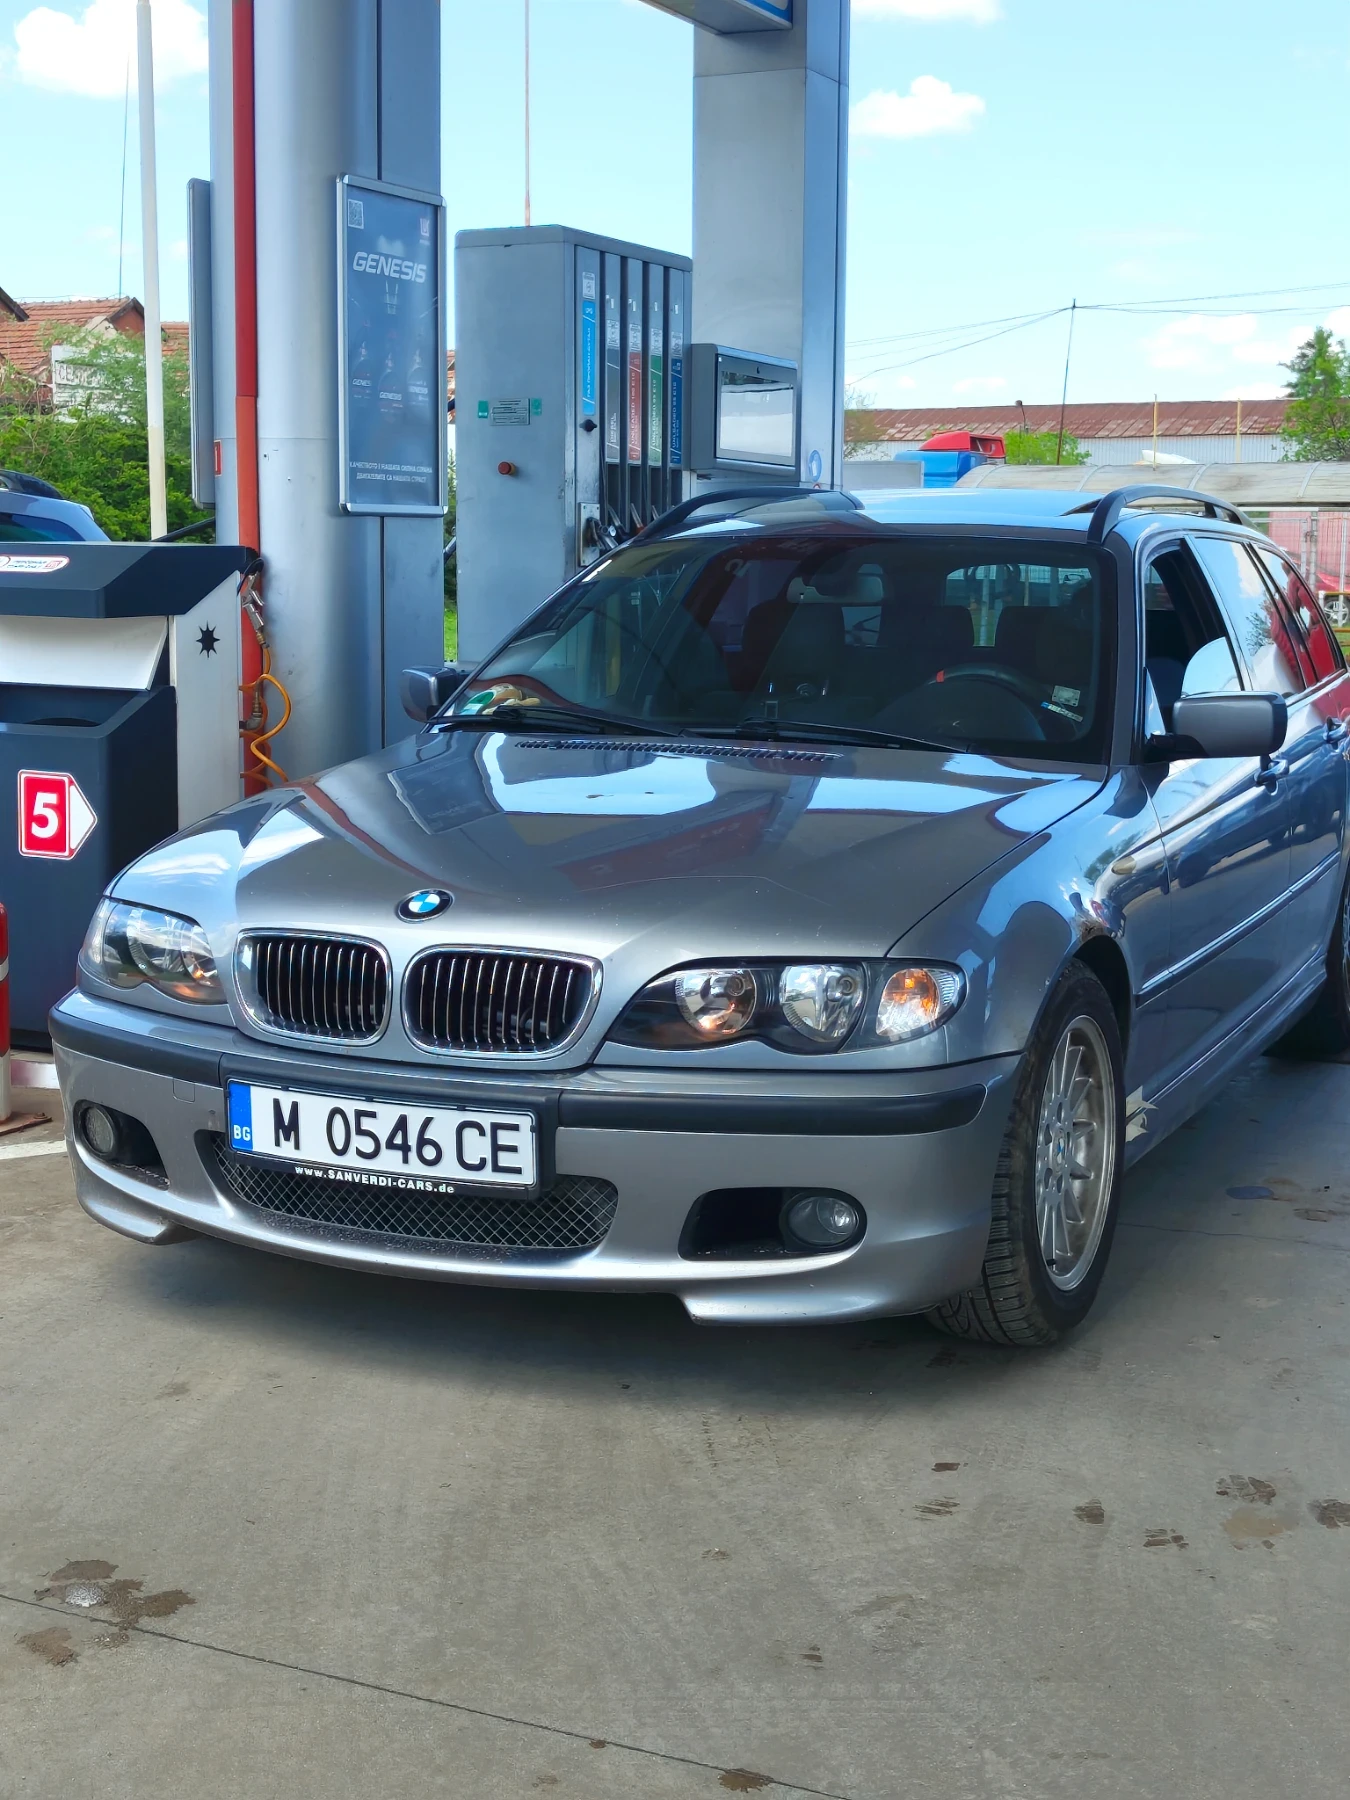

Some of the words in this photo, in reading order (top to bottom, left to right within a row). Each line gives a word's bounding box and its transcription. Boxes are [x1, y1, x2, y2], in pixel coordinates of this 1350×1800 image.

[353, 251, 427, 283] GENESIS
[31, 791, 59, 839] 5
[233, 1124, 251, 1142] BG
[272, 1097, 300, 1151] M
[326, 1106, 443, 1167] 0546
[455, 1120, 523, 1175] CE
[294, 1165, 455, 1194] www.SANVERDI-CARS.de
